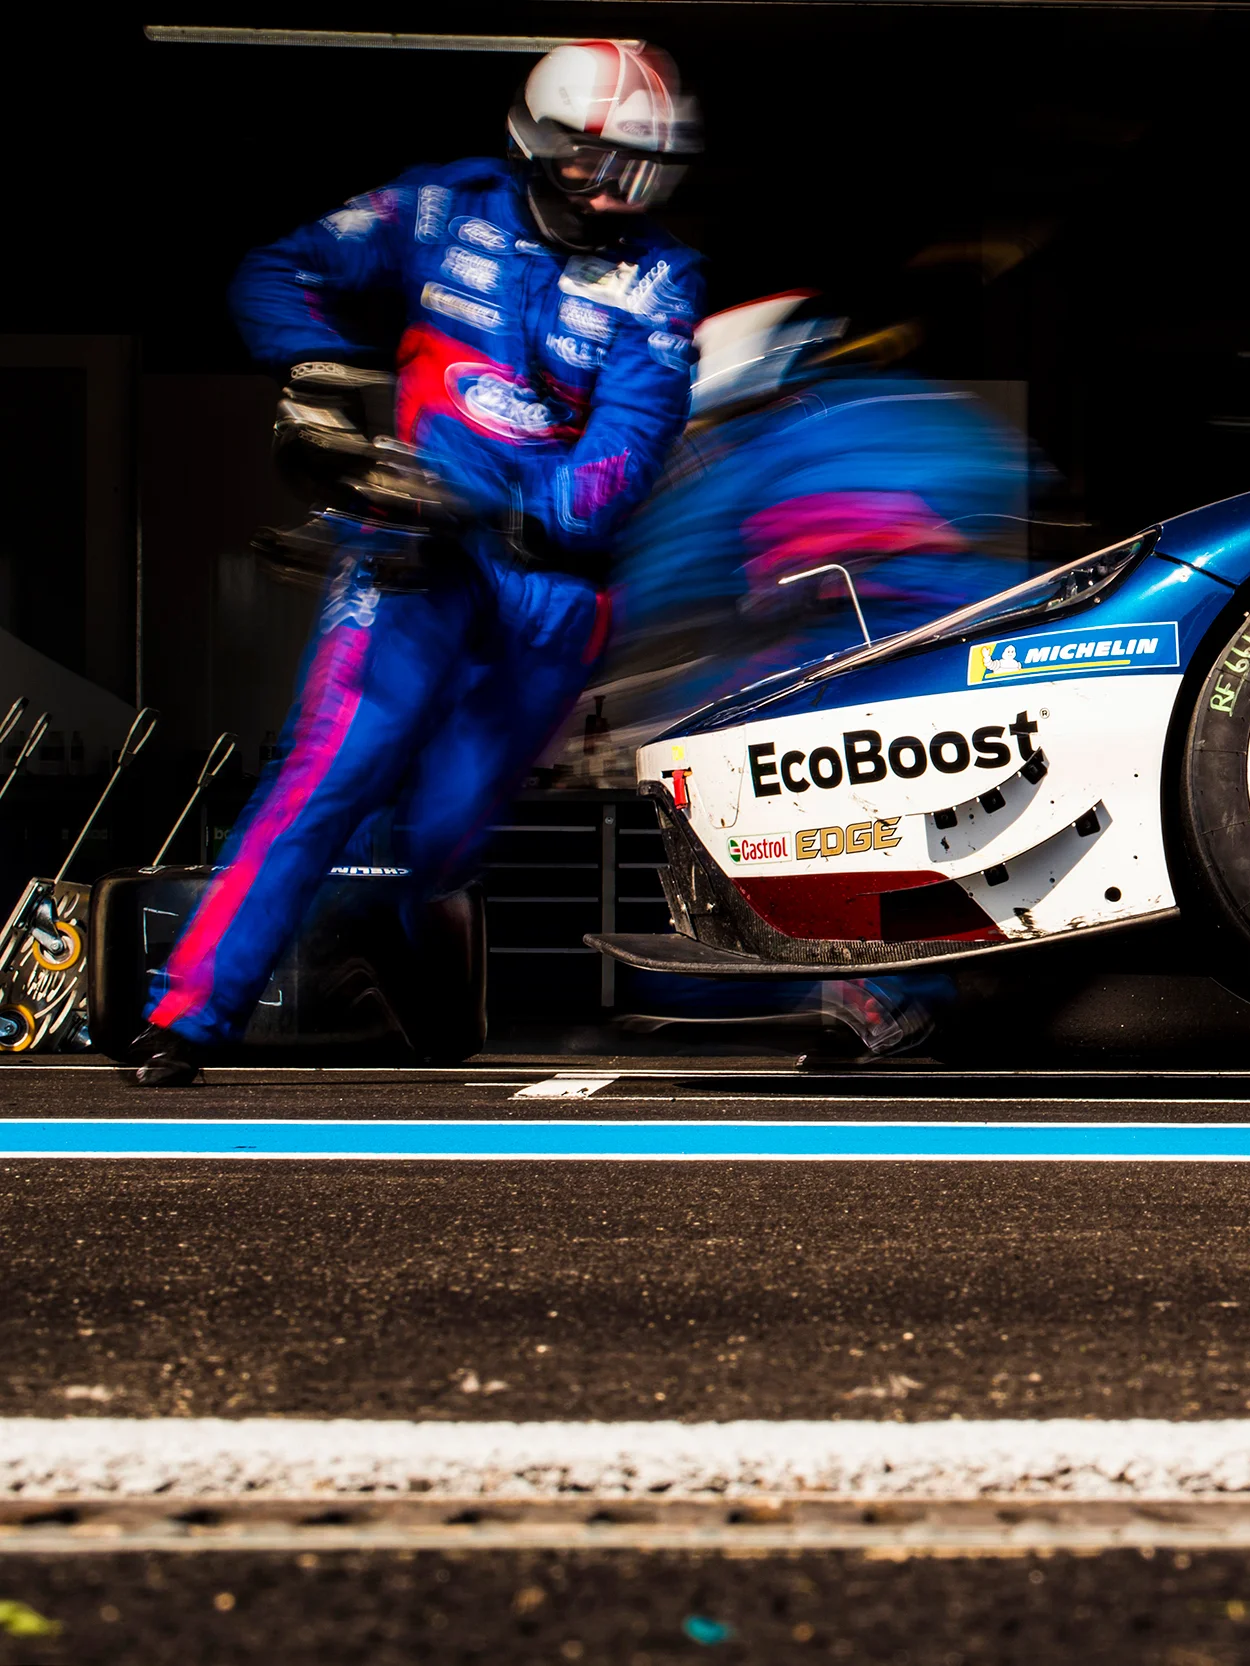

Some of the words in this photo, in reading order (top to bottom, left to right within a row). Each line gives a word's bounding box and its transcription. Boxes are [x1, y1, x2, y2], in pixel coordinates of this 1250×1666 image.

[1024, 637, 1159, 666] MICHELIN
[1209, 674, 1235, 714] RF
[747, 710, 1040, 799] EcoBoost
[741, 837, 788, 861] Castrol
[795, 817, 902, 860] EDGE
[330, 867, 410, 875] CHELIN
